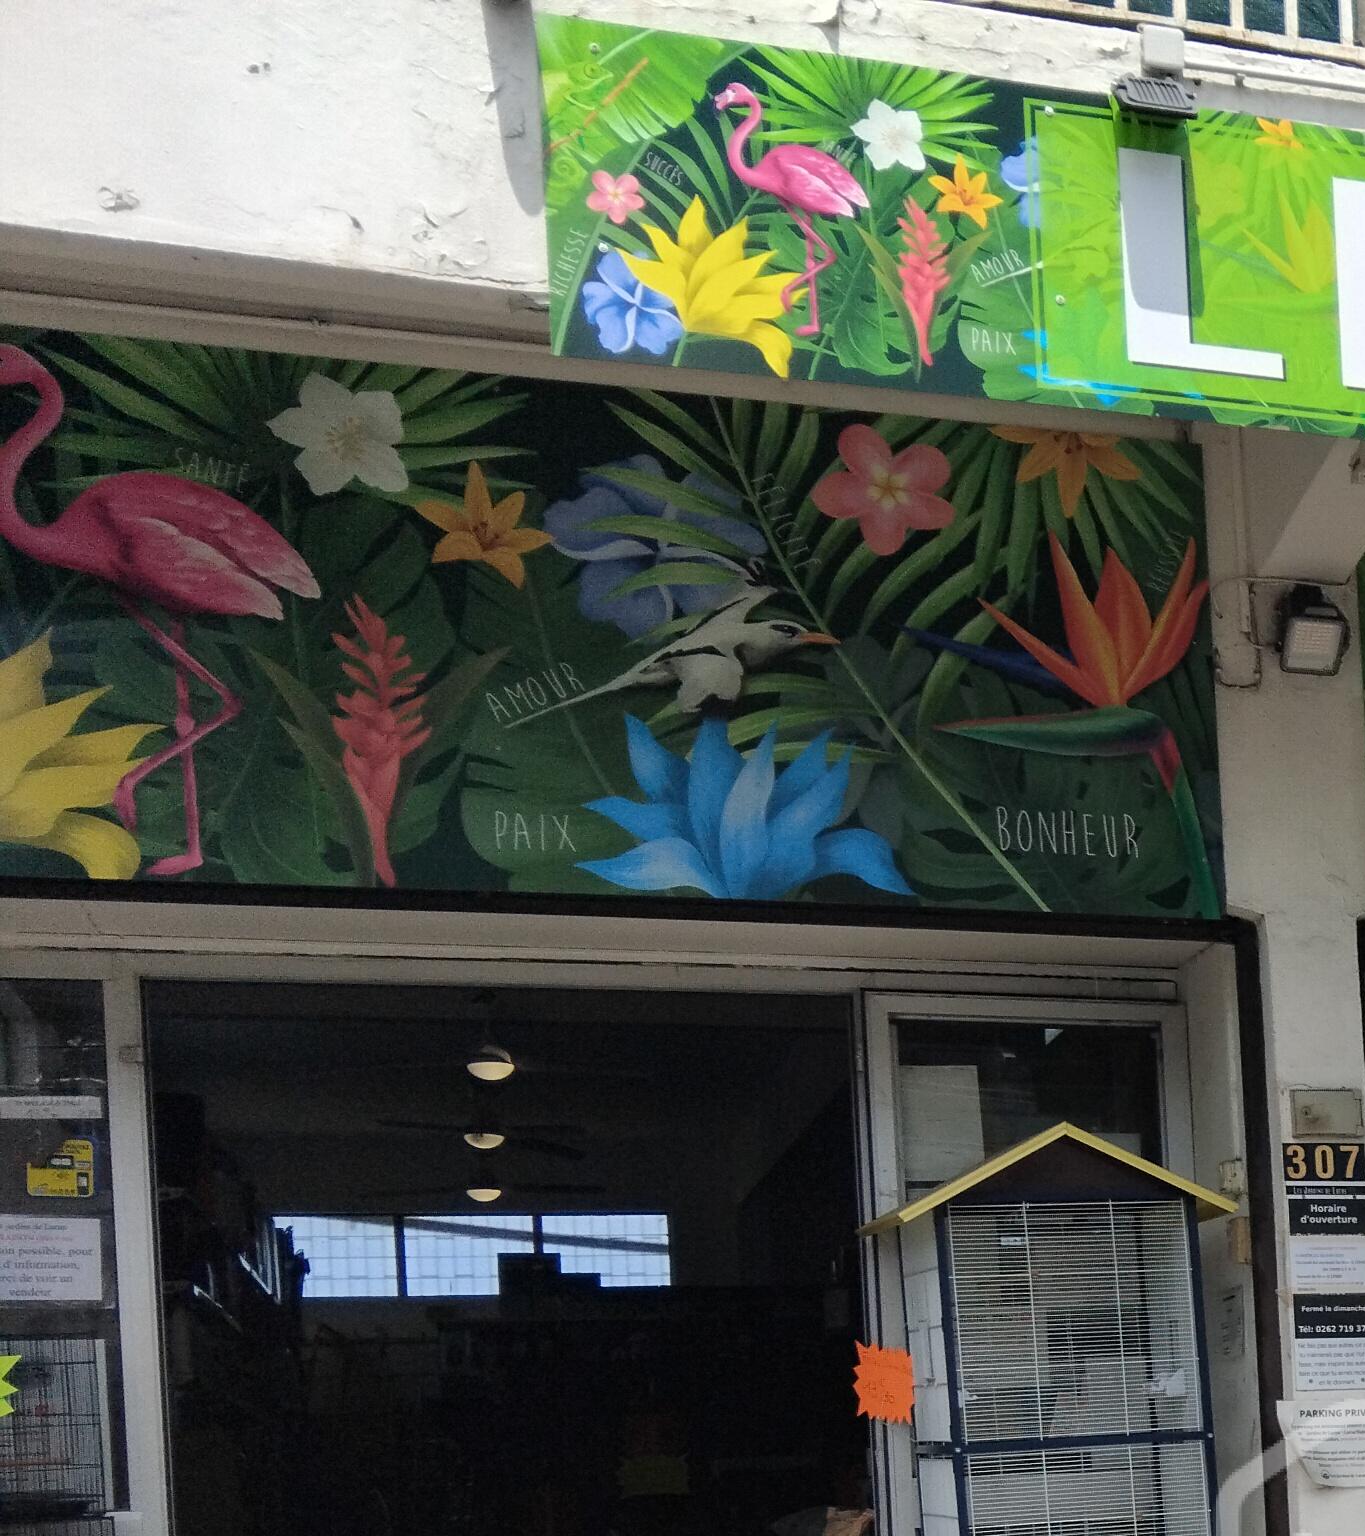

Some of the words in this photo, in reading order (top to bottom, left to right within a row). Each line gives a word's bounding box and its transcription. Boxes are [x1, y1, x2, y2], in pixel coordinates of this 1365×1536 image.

[551, 228, 589, 297] RICHESSE
[970, 249, 1024, 283] AMOUR
[971, 328, 1016, 356] PAIX
[486, 662, 585, 722] AMOUR
[495, 810, 577, 852] PAIX
[996, 806, 1140, 859] BONHEUR
[1286, 1144, 1360, 1180] 307
[1300, 1215, 1358, 1224] d'ouverture
[1310, 1204, 1347, 1213] Horaire
[1315, 1325, 1337, 1333] 0262
[1339, 1325, 1354, 1333] 719
[1300, 1408, 1342, 1418] PARKING
